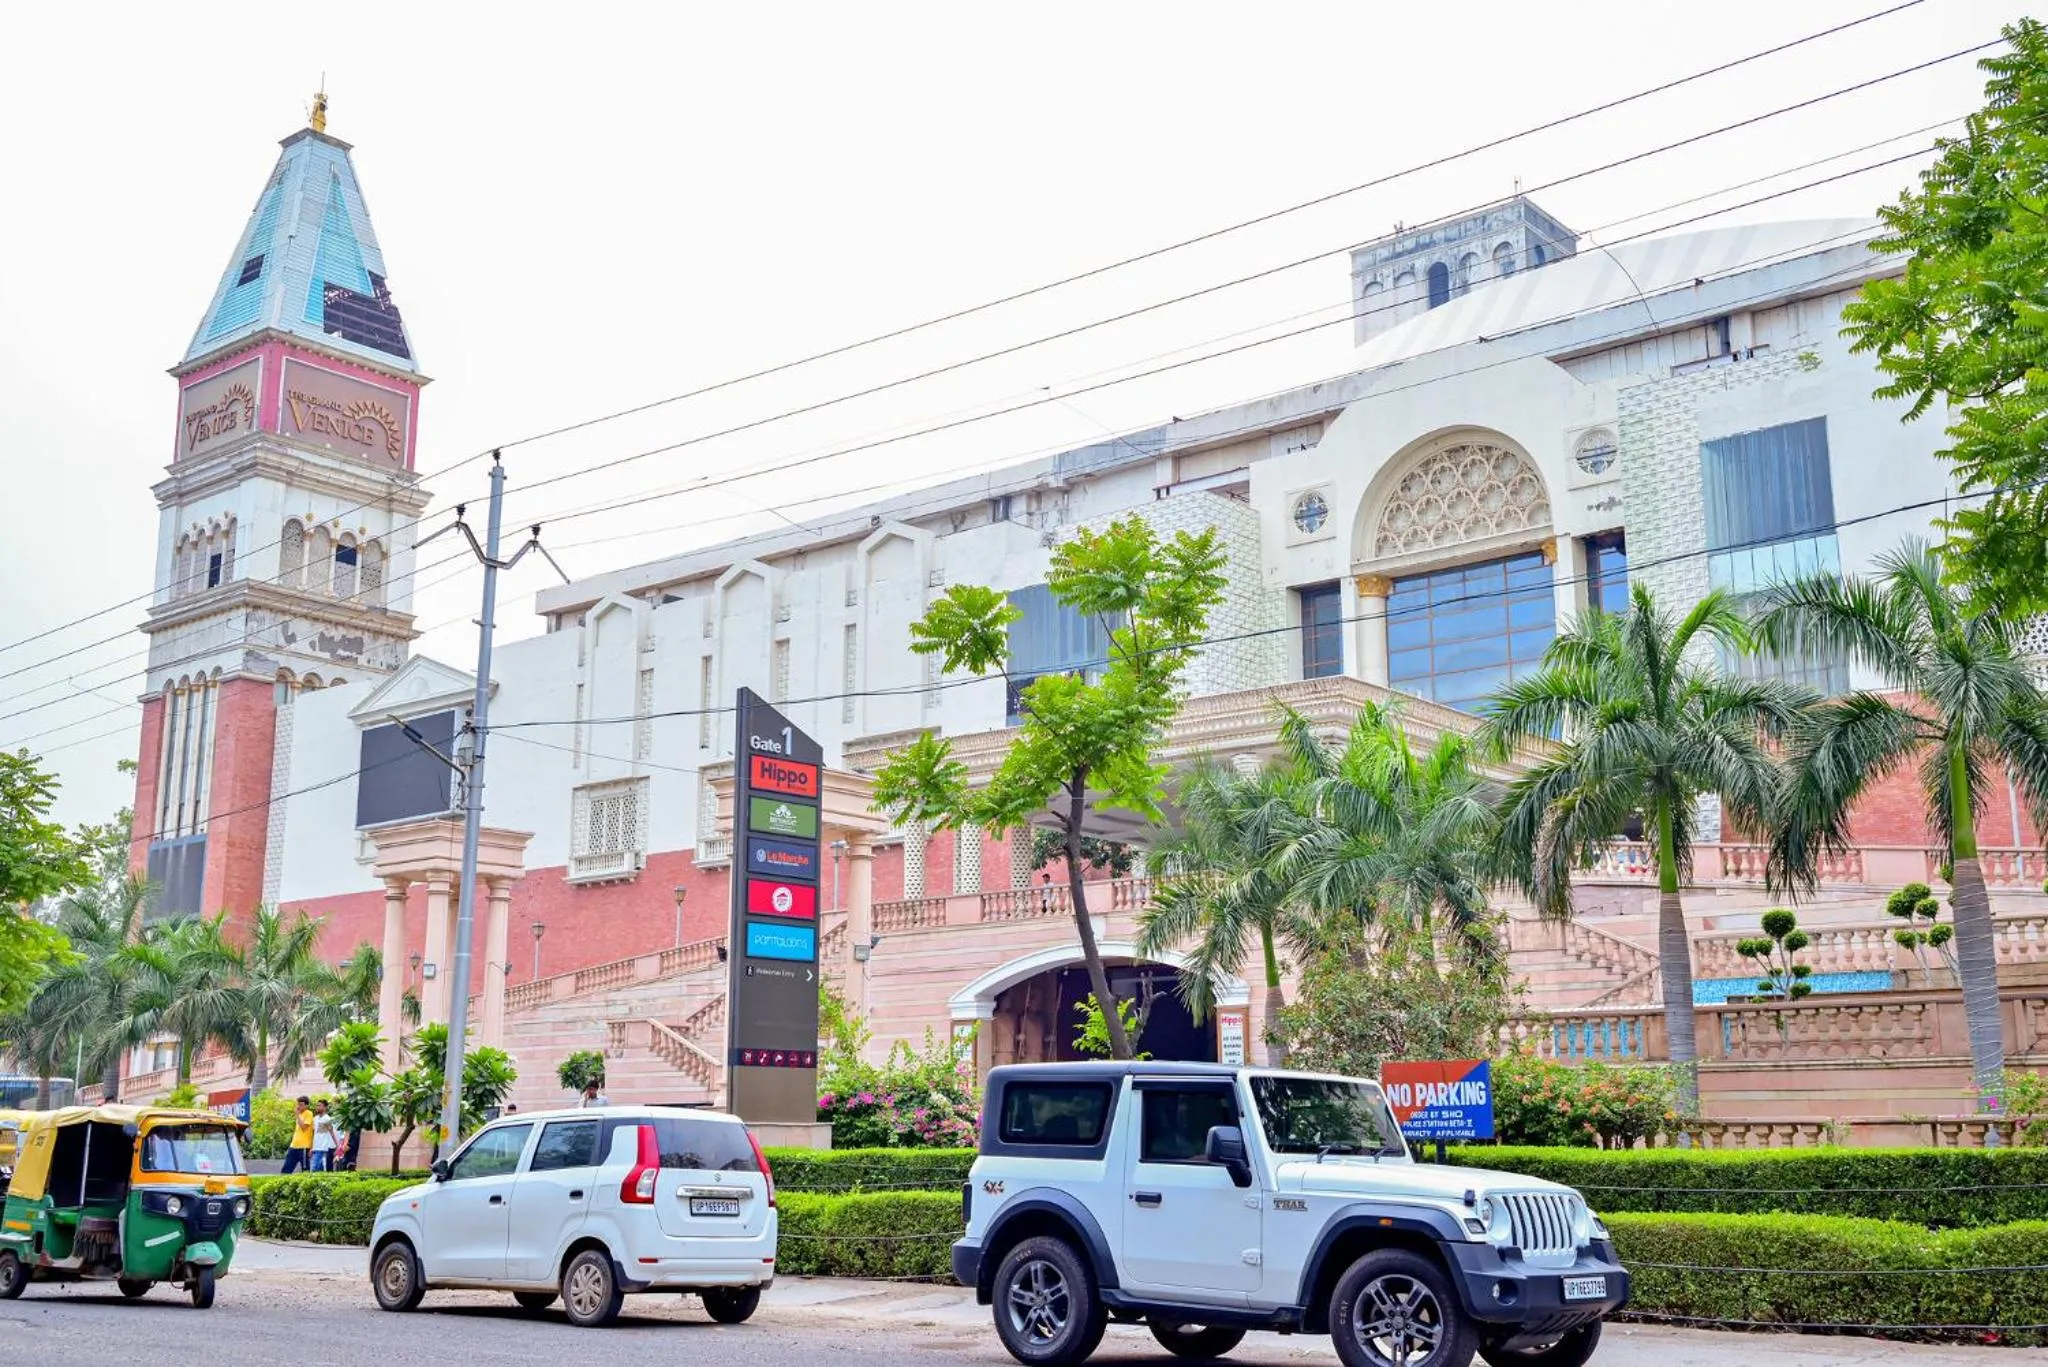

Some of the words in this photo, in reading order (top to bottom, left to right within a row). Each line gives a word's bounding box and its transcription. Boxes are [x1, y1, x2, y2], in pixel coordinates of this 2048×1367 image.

[187, 411, 237, 450] VENICE
[286, 398, 375, 446] VENICE
[750, 735, 782, 753] Gate
[781, 726, 793, 755] 1
[761, 760, 808, 789] Hippo
[1386, 1083, 1412, 1107] NO
[1415, 1081, 1486, 1107] PARKING
[1441, 1110, 1464, 1119] SHO
